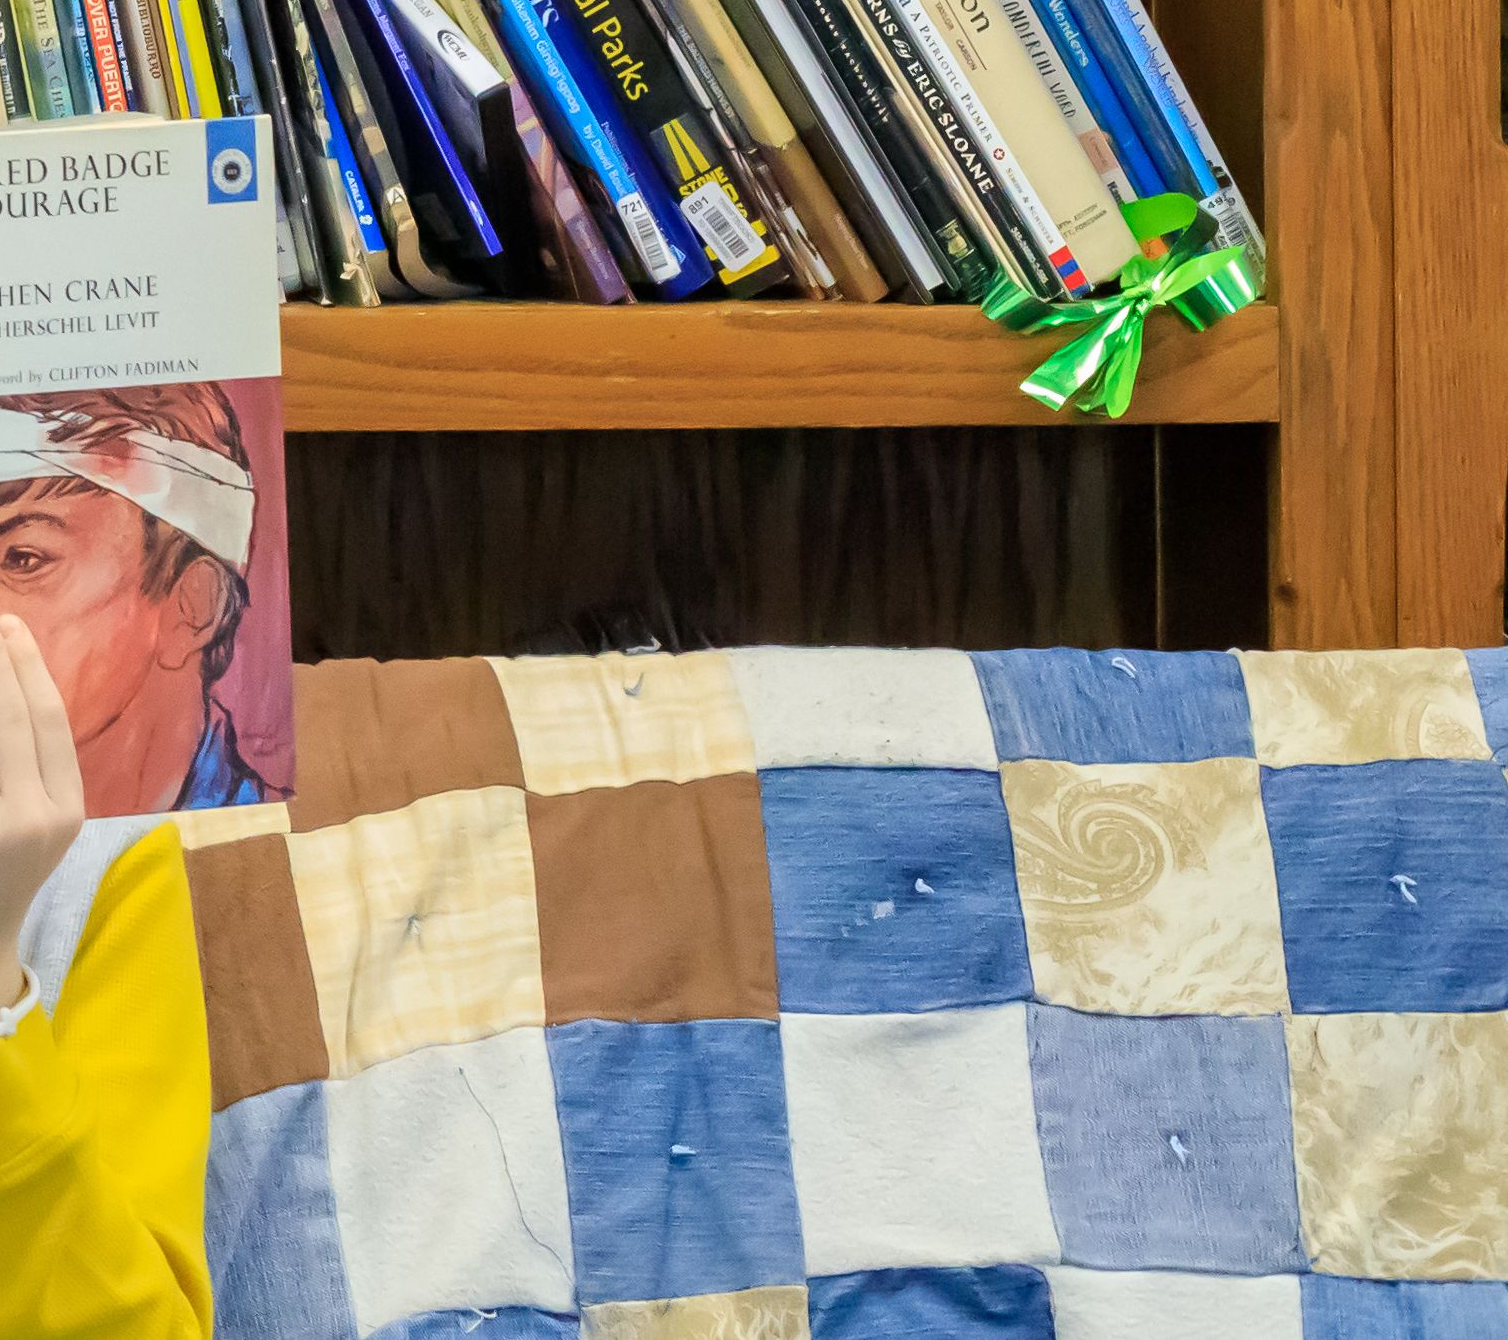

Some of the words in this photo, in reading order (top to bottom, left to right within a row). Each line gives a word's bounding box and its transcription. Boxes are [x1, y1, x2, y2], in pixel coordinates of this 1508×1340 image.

[592, 16, 649, 102] Parks
[905, 60, 945, 110] ERIC
[936, 111, 995, 195] SLOANE
[62, 149, 171, 182] BADGE
[65, 275, 160, 303] CRANE
[106, 311, 160, 330] LEVIT
[49, 364, 118, 382] CLIFTON
[125, 359, 200, 376] FADIMAN
